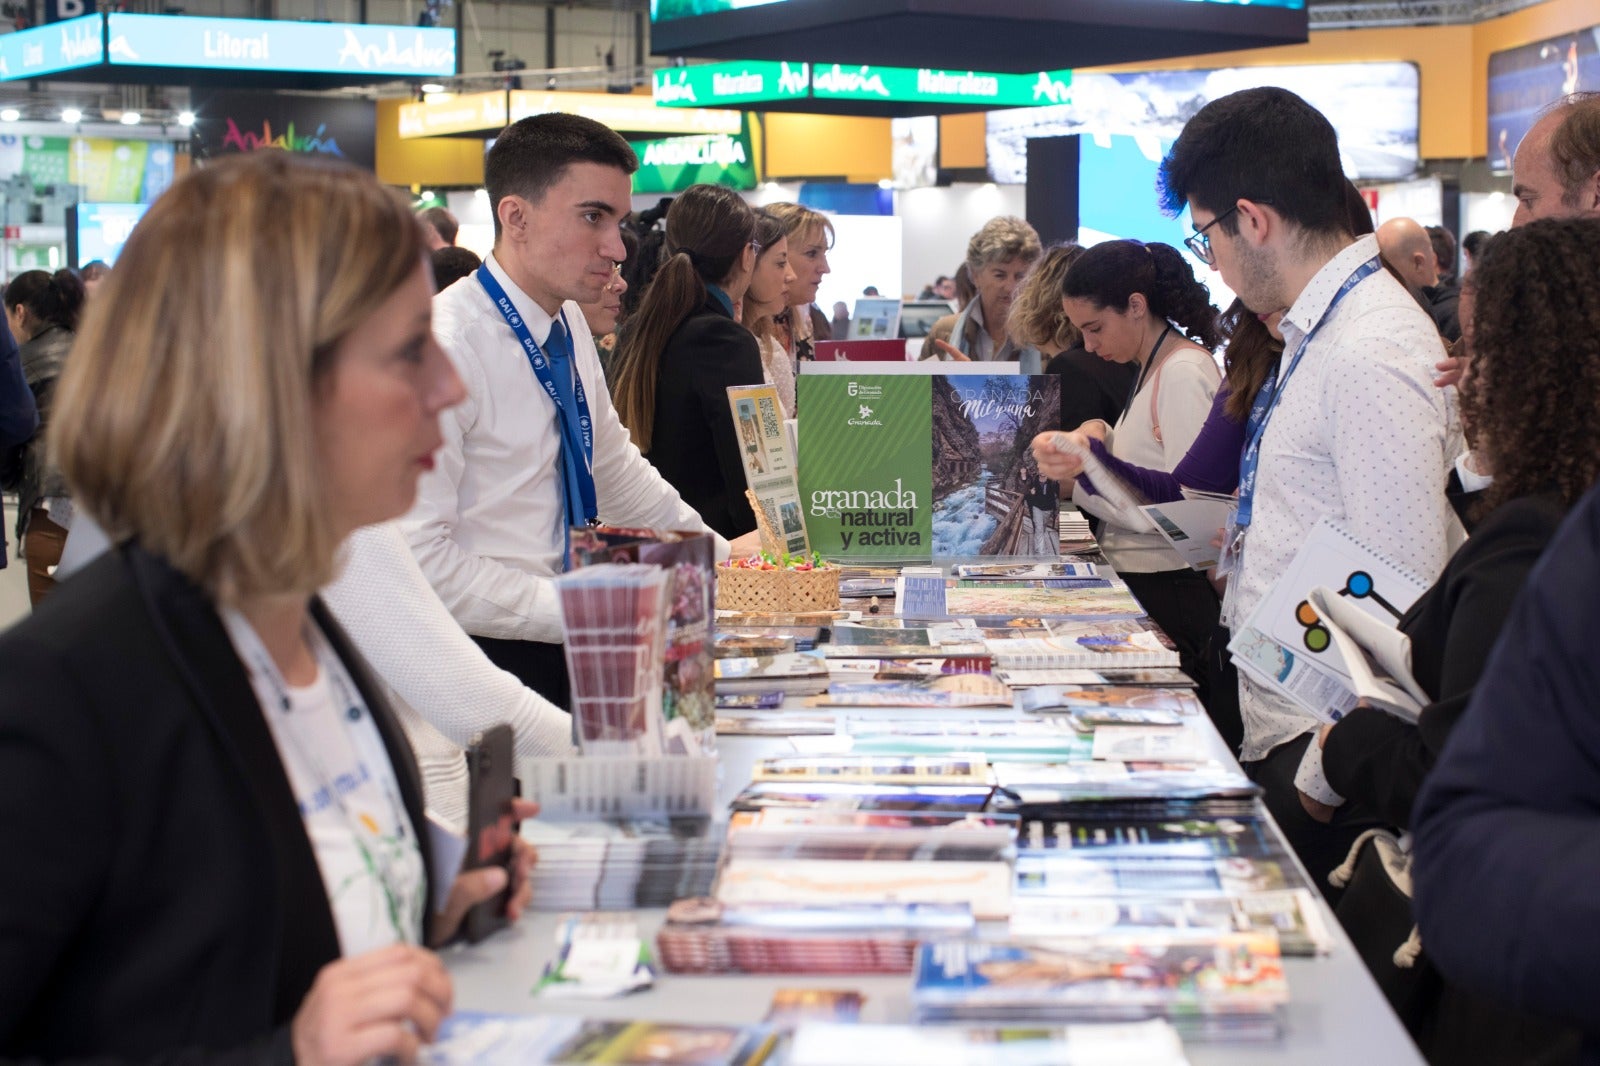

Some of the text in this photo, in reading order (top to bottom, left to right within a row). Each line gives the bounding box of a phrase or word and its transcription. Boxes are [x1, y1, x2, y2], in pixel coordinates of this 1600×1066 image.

[203, 31, 269, 60] Litoral
[950, 389, 1045, 404] GRANADA
[847, 417, 883, 426] Granada
[959, 399, 995, 420] Mil
[1006, 403, 1036, 427] una
[810, 477, 919, 517] granada
[841, 507, 914, 527] natural
[840, 528, 921, 551] y activa
